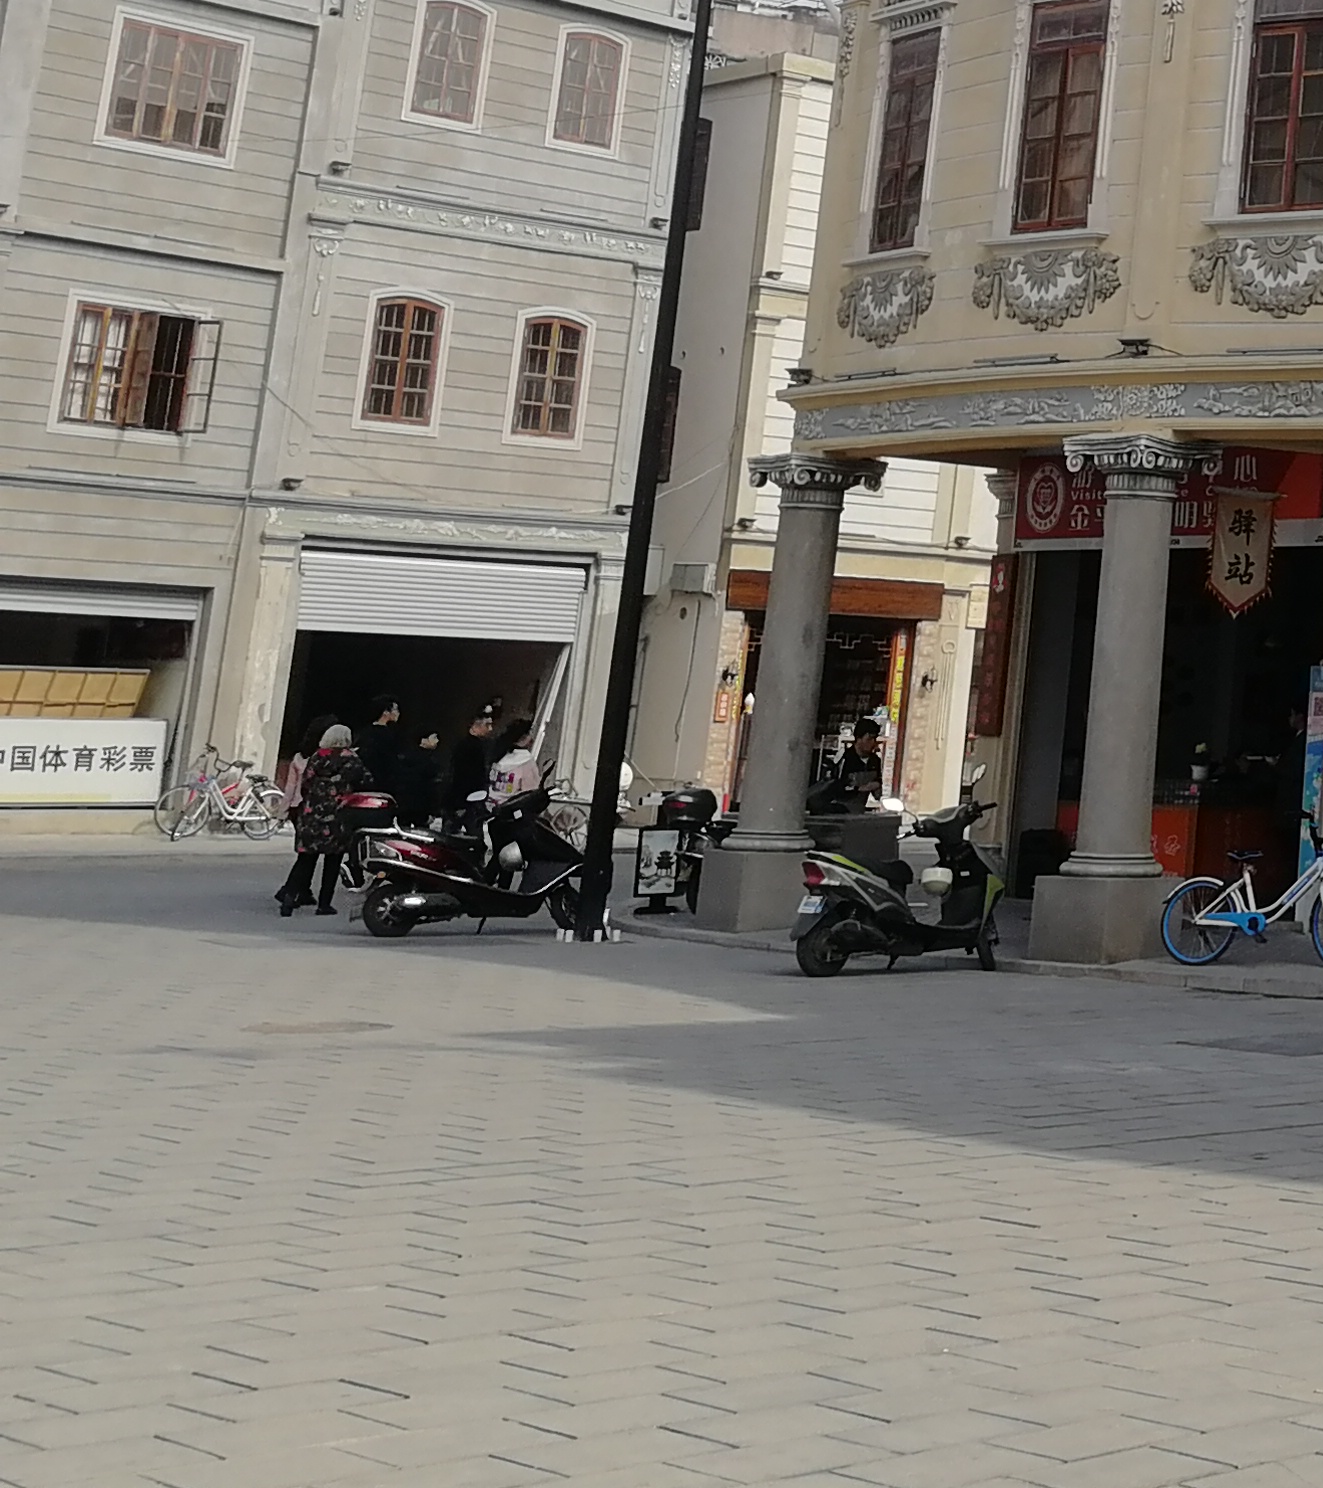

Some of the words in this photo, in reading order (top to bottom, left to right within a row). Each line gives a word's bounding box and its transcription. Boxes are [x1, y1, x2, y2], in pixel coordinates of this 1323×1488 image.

[1070, 489, 1104, 502] Visit
[1225, 507, 1258, 586] 驿站
[0, 744, 157, 772] 国体育彩票
